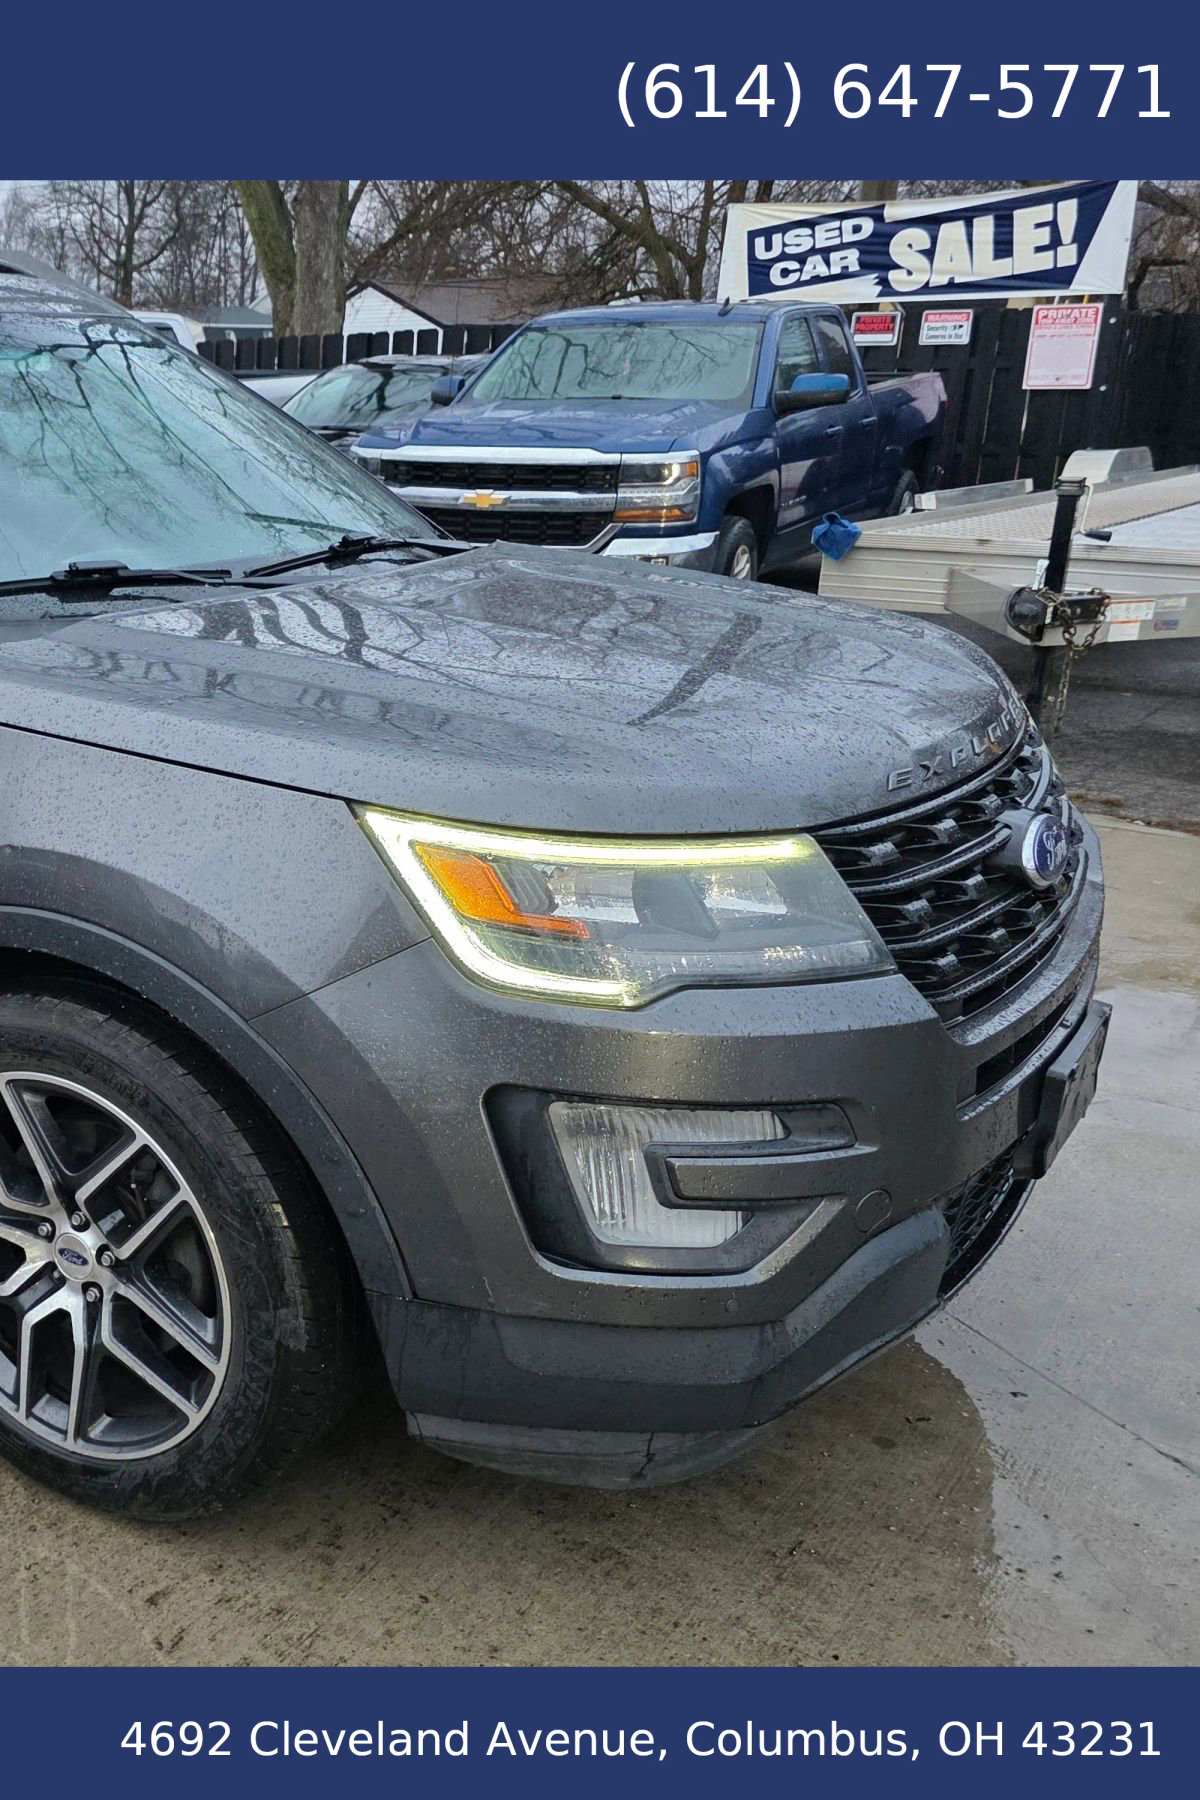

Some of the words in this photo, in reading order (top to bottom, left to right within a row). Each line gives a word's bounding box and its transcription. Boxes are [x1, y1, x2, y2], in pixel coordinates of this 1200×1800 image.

[754, 216, 874, 260] USED
[888, 198, 1078, 292] SALE!
[769, 249, 860, 286] CAR
[927, 313, 967, 322] WARNING
[1038, 308, 1097, 320] PRIVATE
[855, 324, 895, 333] PROPERTY
[926, 325, 948, 333] Security
[62, 1250, 84, 1265] Ford
